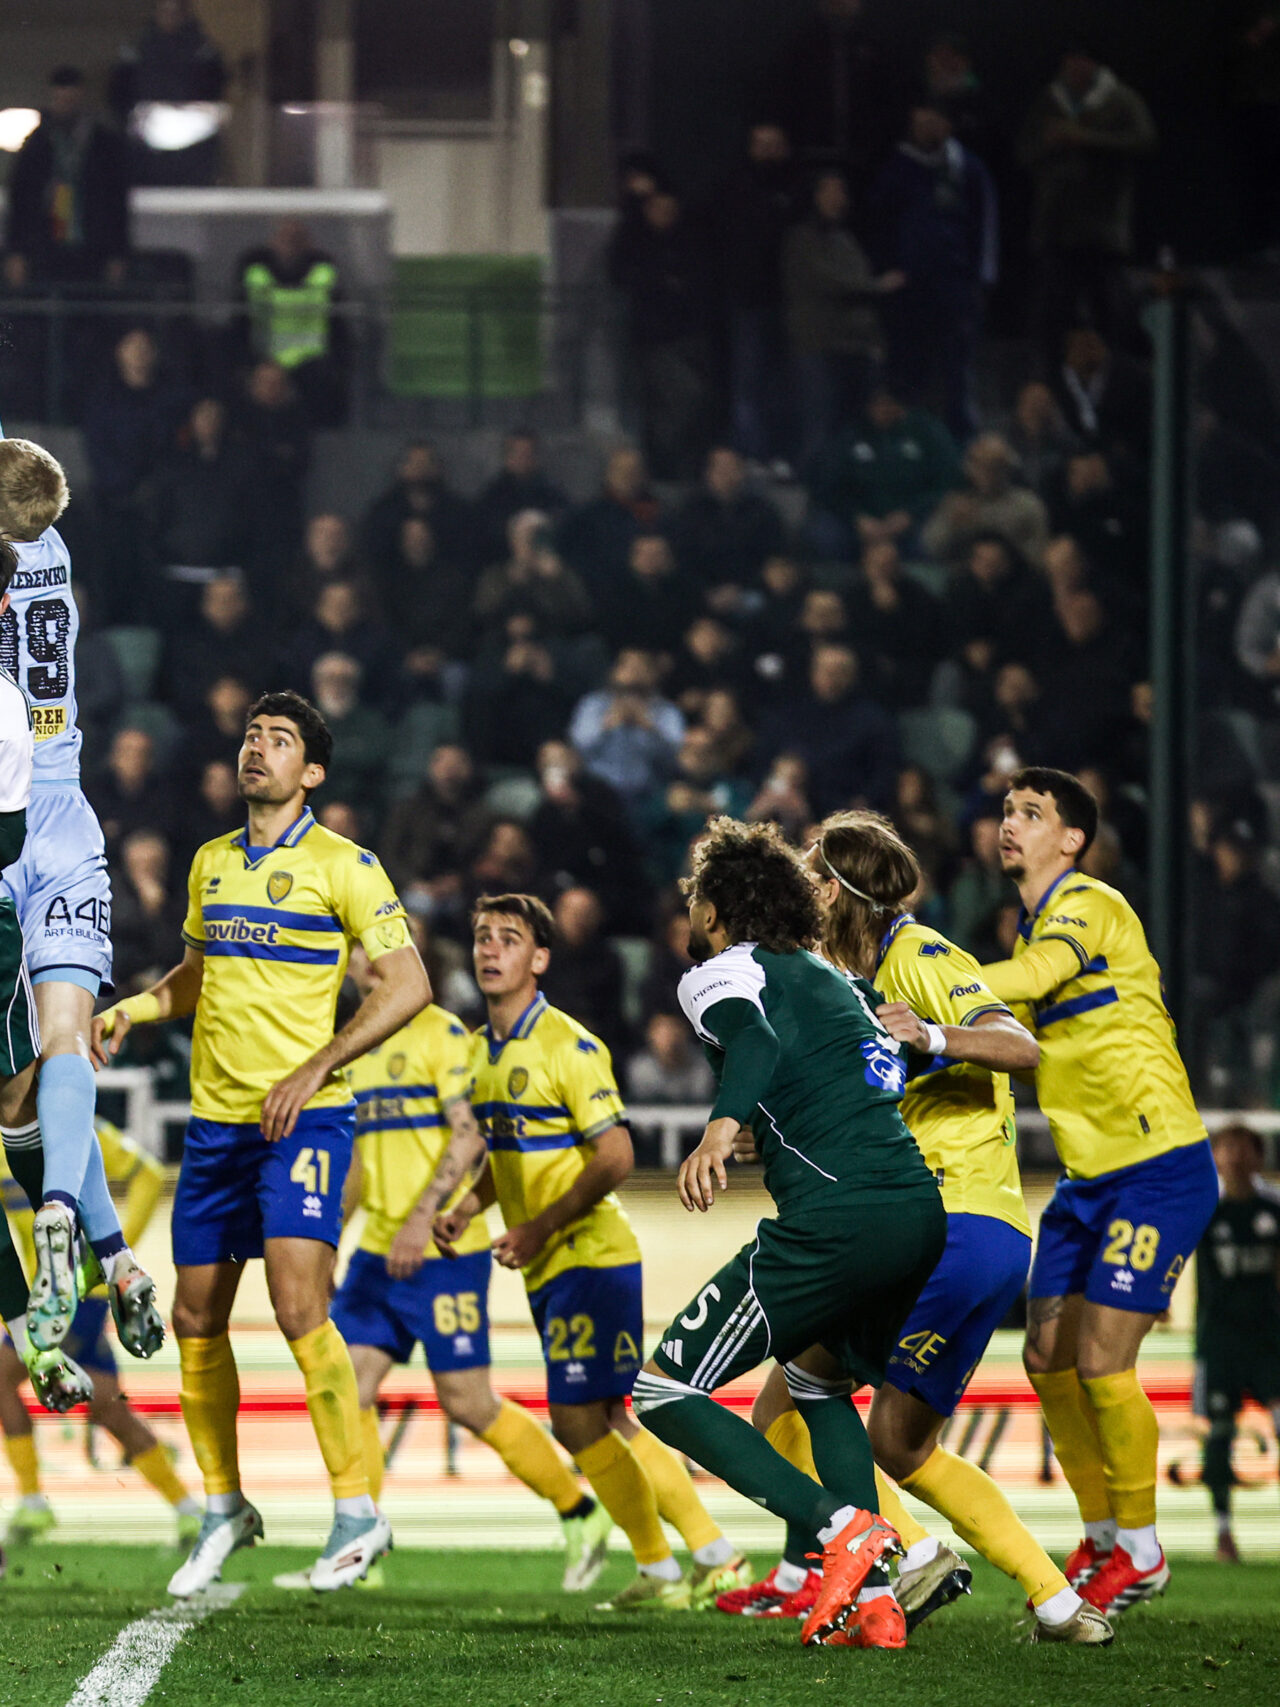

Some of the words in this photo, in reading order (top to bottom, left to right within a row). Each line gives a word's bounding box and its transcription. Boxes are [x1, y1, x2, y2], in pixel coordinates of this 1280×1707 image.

[32, 708, 63, 725] ΩΣΗ
[34, 725, 60, 735] ΝΙΟΥ
[290, 1147, 330, 1196] 41
[1102, 1218, 1160, 1271] 28
[433, 1292, 480, 1336] 65
[680, 1283, 721, 1330] 5
[547, 1314, 596, 1360] 22
